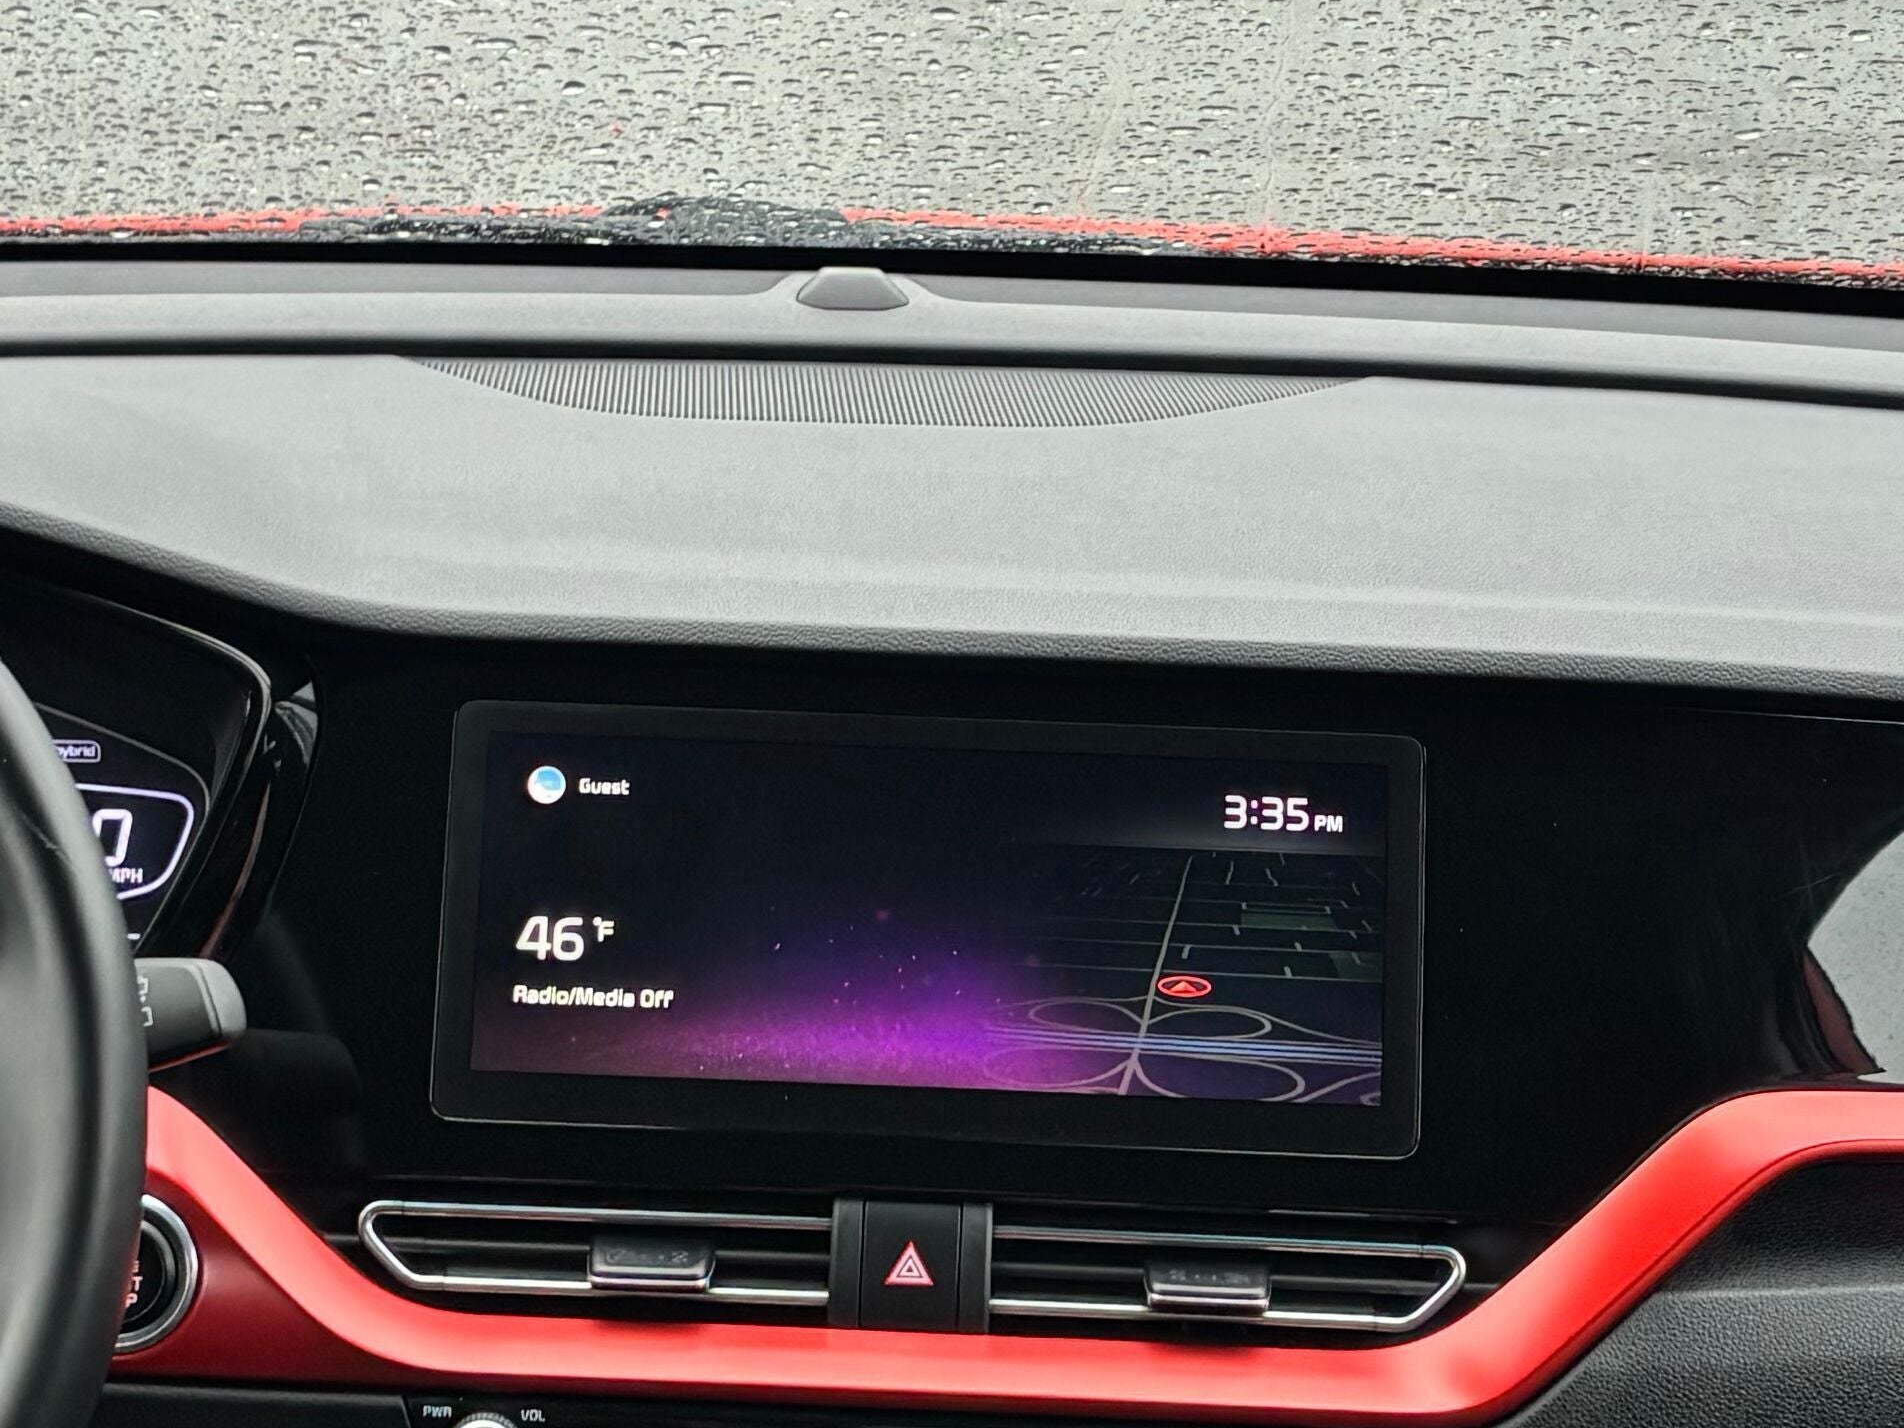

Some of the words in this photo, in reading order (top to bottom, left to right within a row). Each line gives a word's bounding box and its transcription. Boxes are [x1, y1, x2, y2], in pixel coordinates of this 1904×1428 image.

[579, 778, 630, 795] Guest
[1223, 795, 1310, 832] 3:35
[1314, 814, 1344, 832] PM
[516, 915, 585, 961] 46
[512, 984, 636, 1008] Radio/Media
[640, 988, 675, 1008] Off
[423, 1404, 452, 1418] PWR
[520, 1408, 546, 1422] VOL
